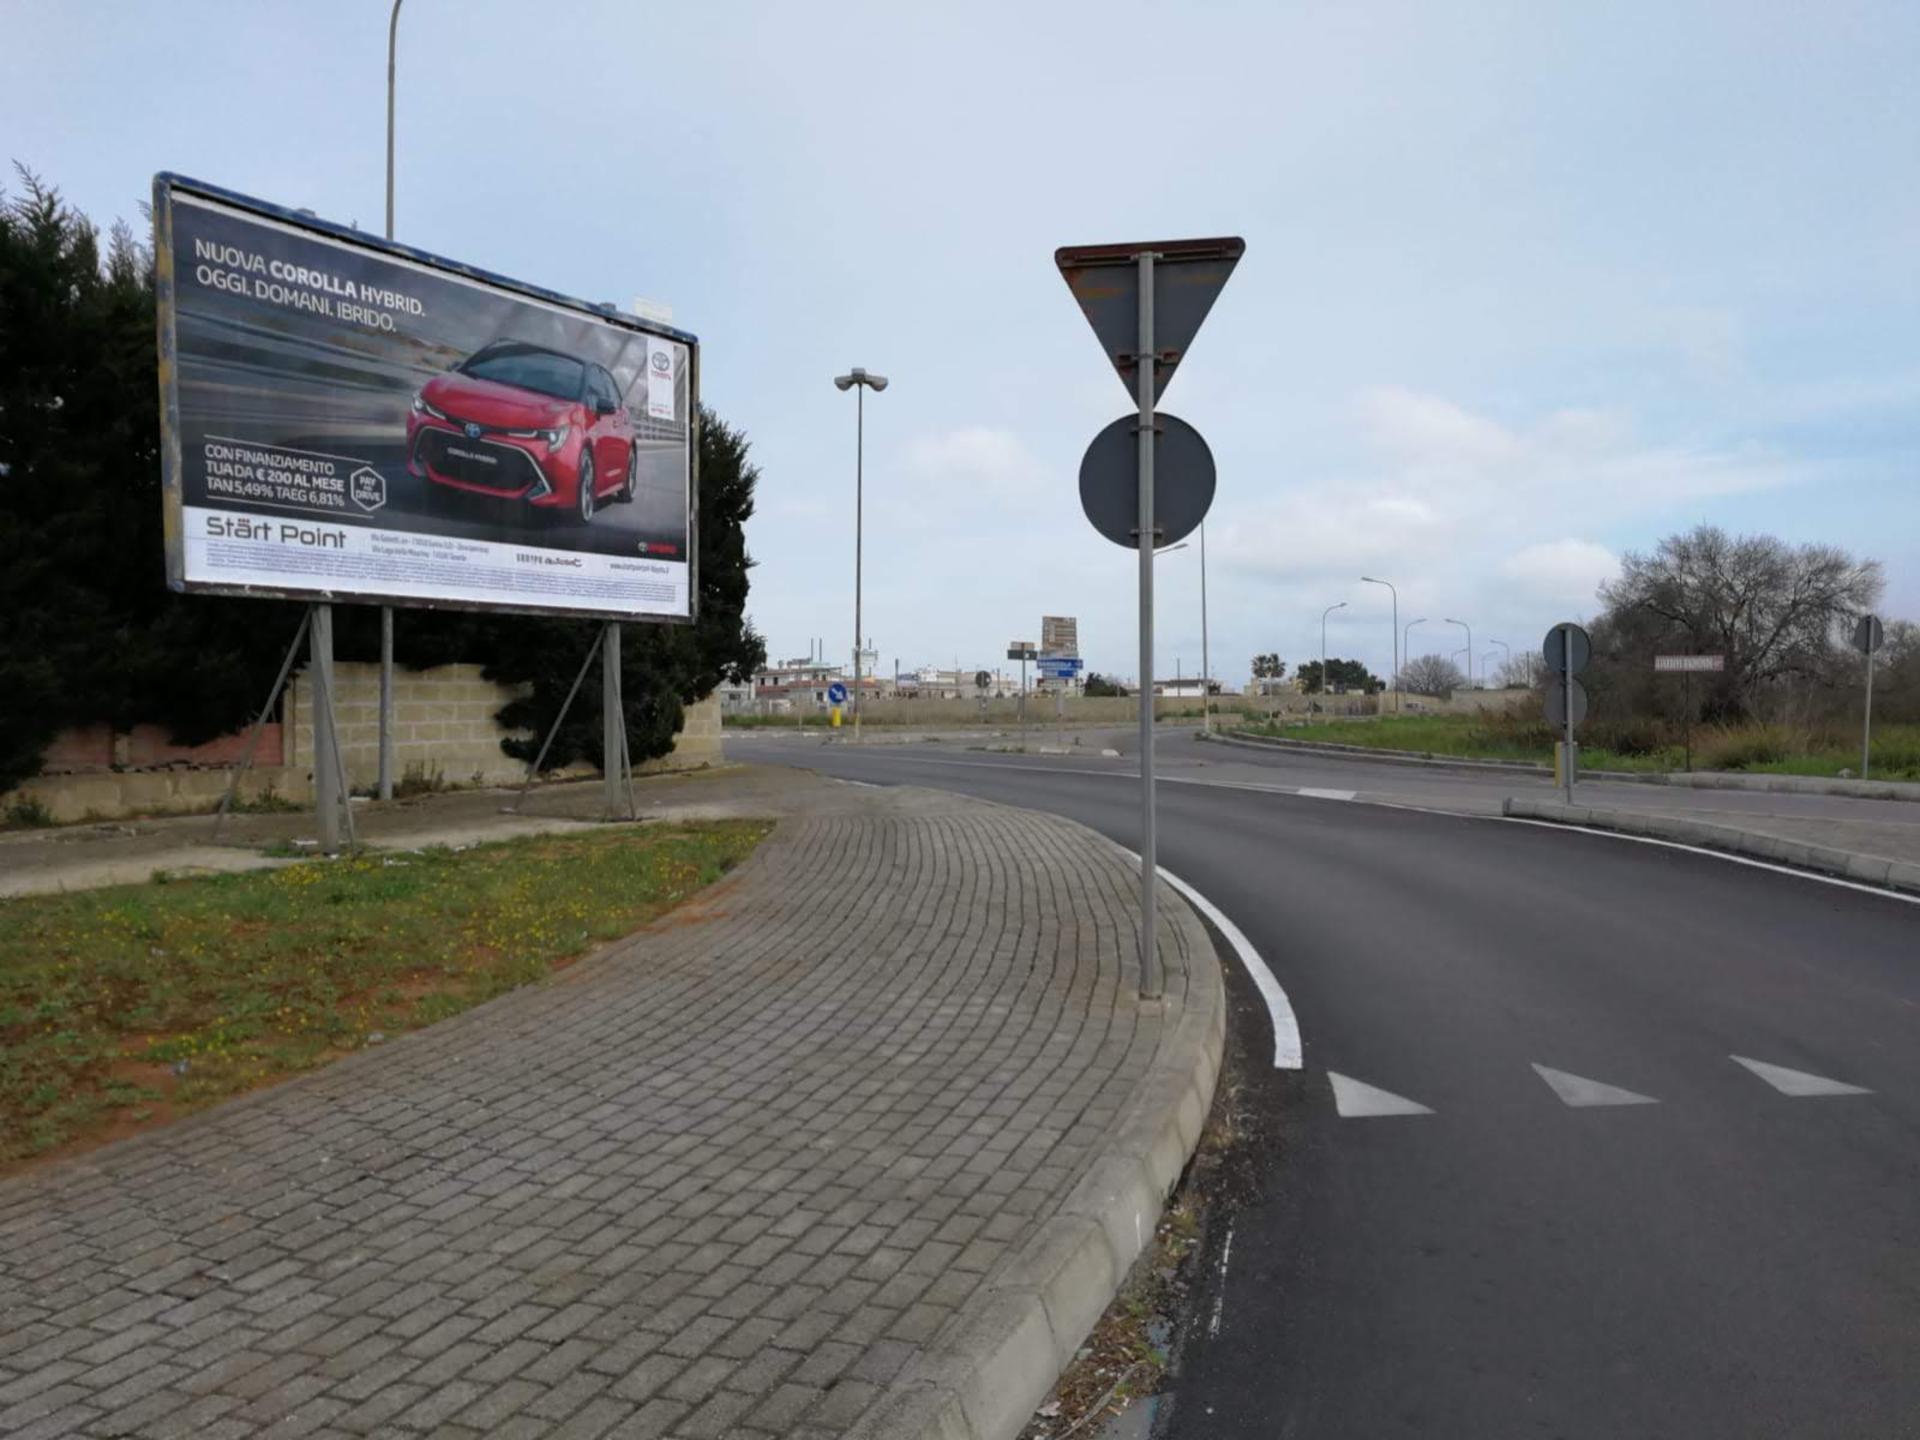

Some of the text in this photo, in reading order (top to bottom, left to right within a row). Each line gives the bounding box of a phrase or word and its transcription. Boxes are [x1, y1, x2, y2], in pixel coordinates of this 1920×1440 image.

[195, 238, 426, 317] NUOVA COROLLA HYBRID.
[196, 264, 397, 333] OGGI. DOMANI. IBRIDO.
[204, 444, 335, 476] CON FINANZIAMENTO
[206, 460, 233, 477] TUA
[234, 465, 254, 480] DA
[266, 469, 293, 485] 200
[293, 474, 311, 488] AL
[312, 477, 345, 493] MESE
[206, 477, 234, 492] TAN
[234, 480, 273, 499] 5,49%
[276, 485, 308, 503] TAEG
[280, 524, 347, 549] Point
